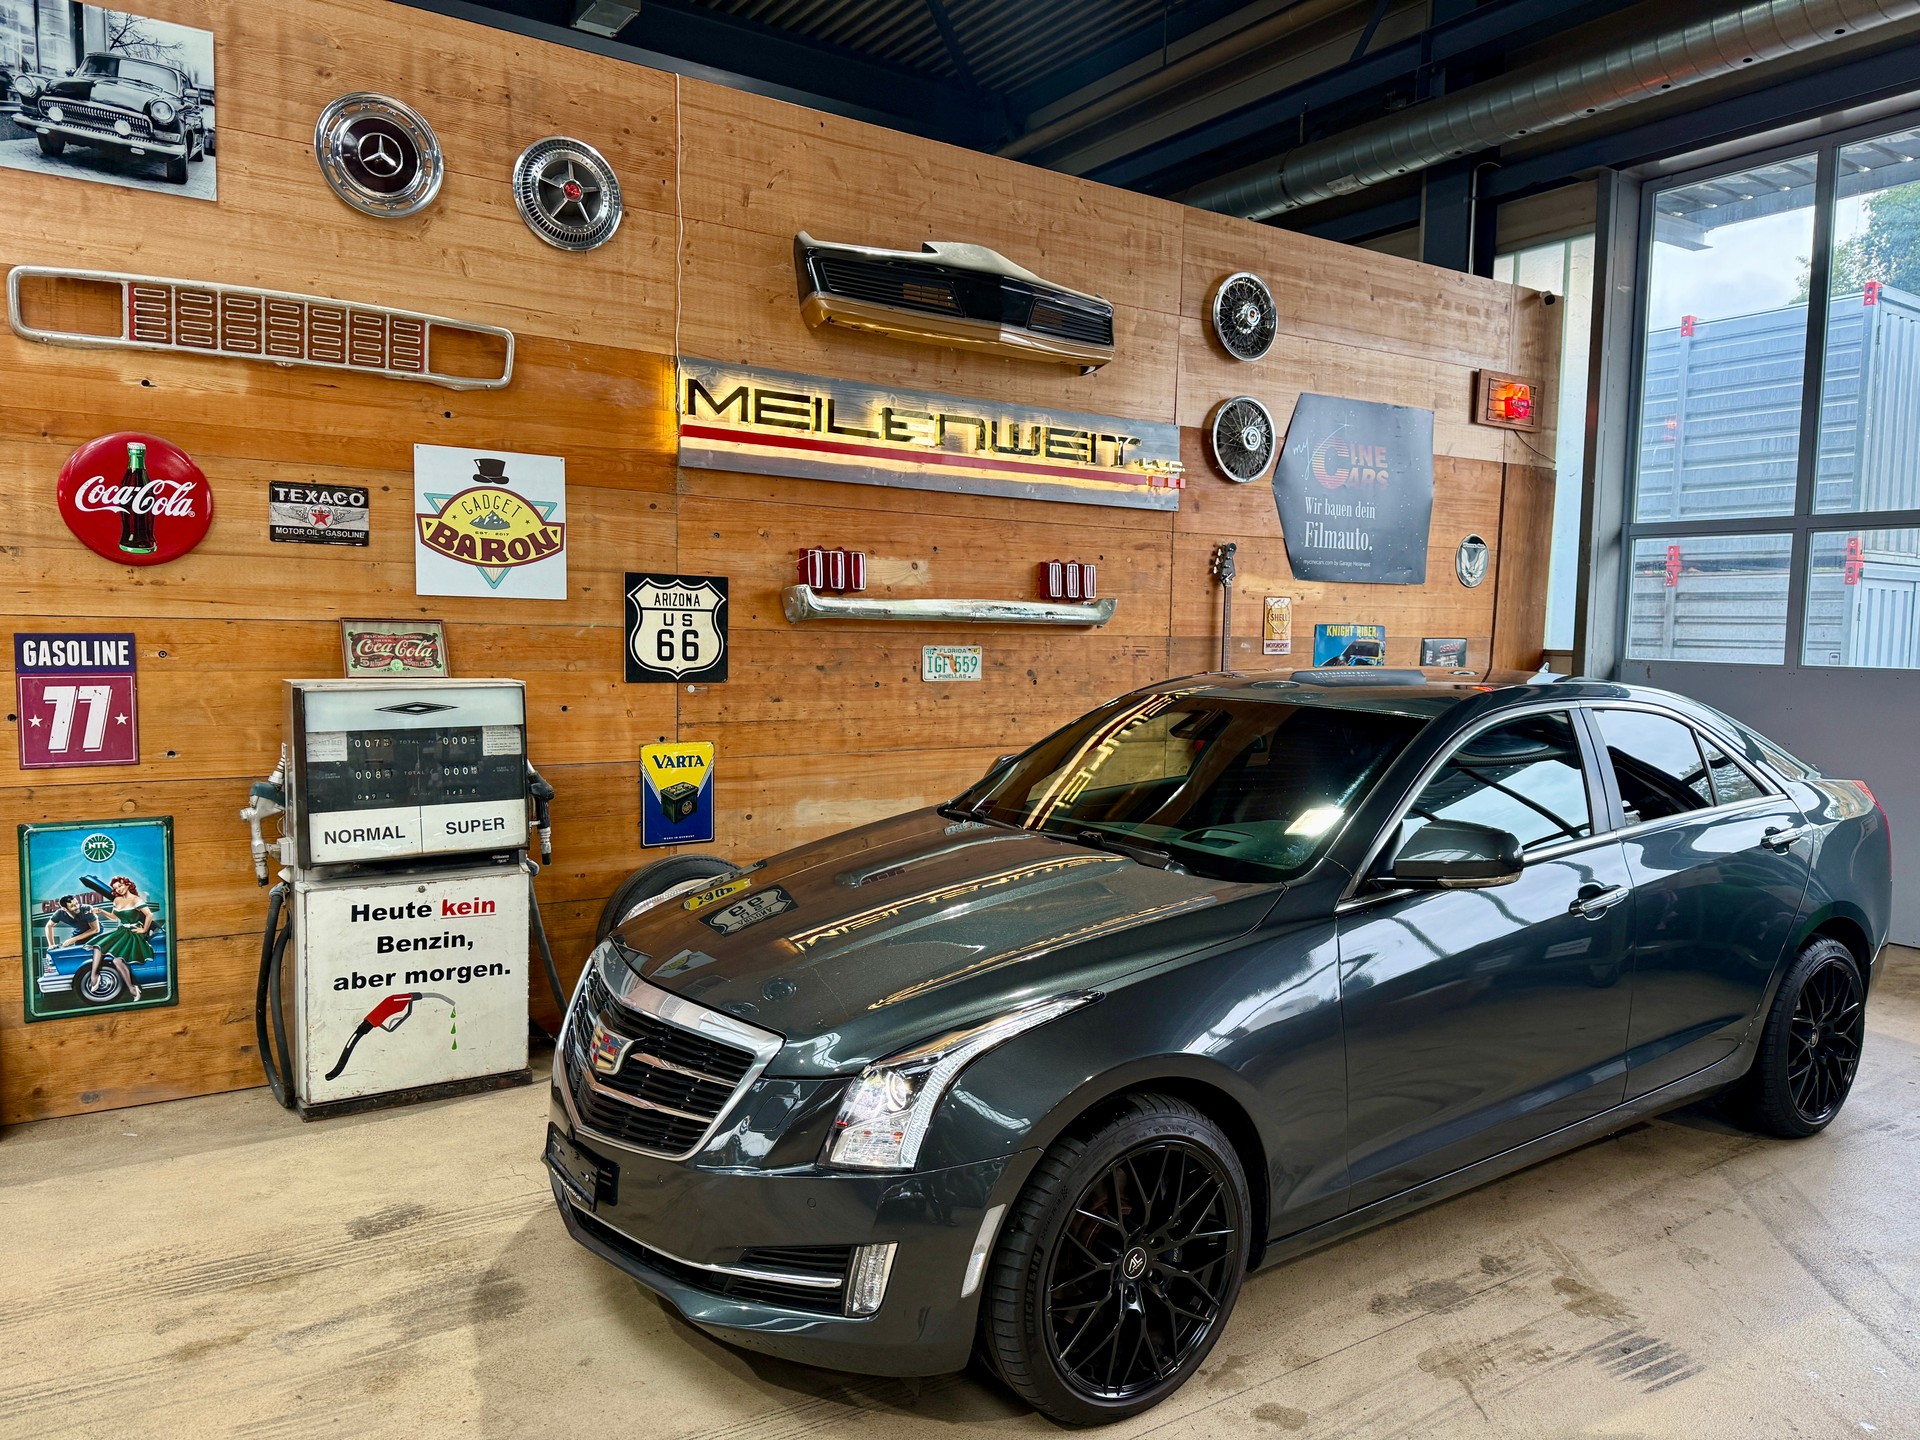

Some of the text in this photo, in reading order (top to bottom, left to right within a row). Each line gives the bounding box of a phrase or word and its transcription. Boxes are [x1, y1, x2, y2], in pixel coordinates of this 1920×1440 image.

[75, 475, 197, 517] Coca-Cola
[274, 486, 365, 506] TEXACO
[461, 494, 522, 518] GADGET
[1305, 496, 1376, 519] Wir bauen dein
[275, 527, 305, 535] MOTOR
[325, 530, 365, 539] GASOLINE
[426, 521, 559, 562] BARON
[1304, 521, 1373, 551] Filmauto.
[654, 592, 701, 607] ARIZONA
[1270, 613, 1289, 622] SHELL
[1326, 625, 1354, 637] KNIGHT
[22, 640, 130, 667] GASOLINE
[356, 639, 435, 657] Coca-Cola
[657, 629, 699, 661] 66
[42, 685, 113, 753] 77
[652, 754, 705, 769] VARTA
[324, 825, 406, 845] NORMAL
[445, 817, 505, 835] SUPER
[87, 841, 109, 850] NTK
[350, 897, 497, 923] Heute kein
[376, 931, 474, 954] Benzin,
[333, 962, 511, 991] aber morgen.
[1025, 1250, 1043, 1335] MICHELIN
